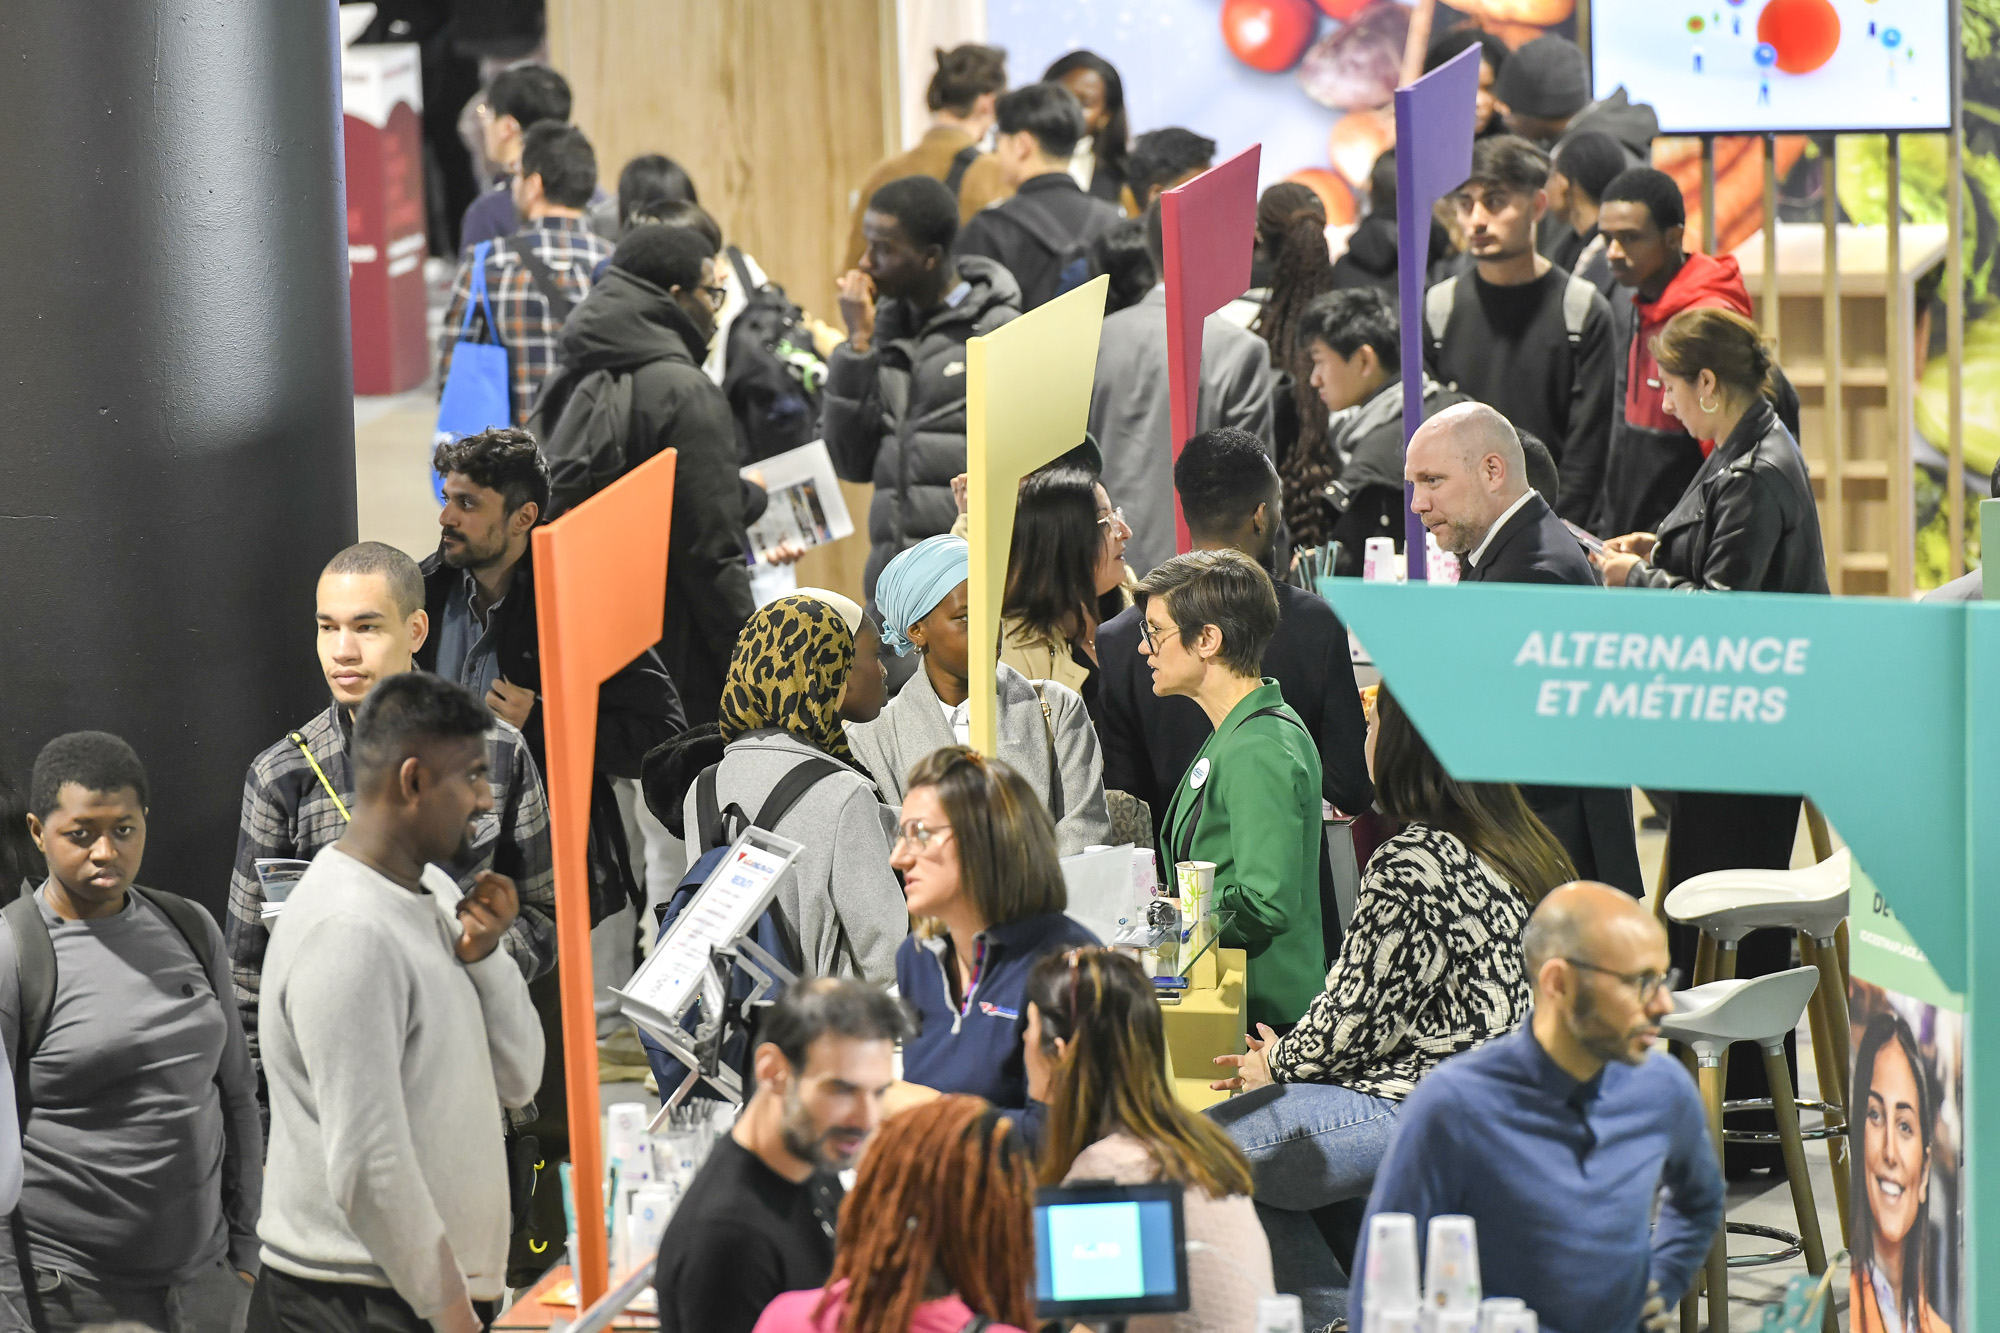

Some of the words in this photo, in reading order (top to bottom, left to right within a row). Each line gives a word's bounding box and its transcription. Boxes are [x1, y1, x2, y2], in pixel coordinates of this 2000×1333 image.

[1514, 631, 1809, 673] ALTERNANCE
[1535, 679, 1591, 716] ET
[1594, 673, 1788, 723] MÉTIERS
